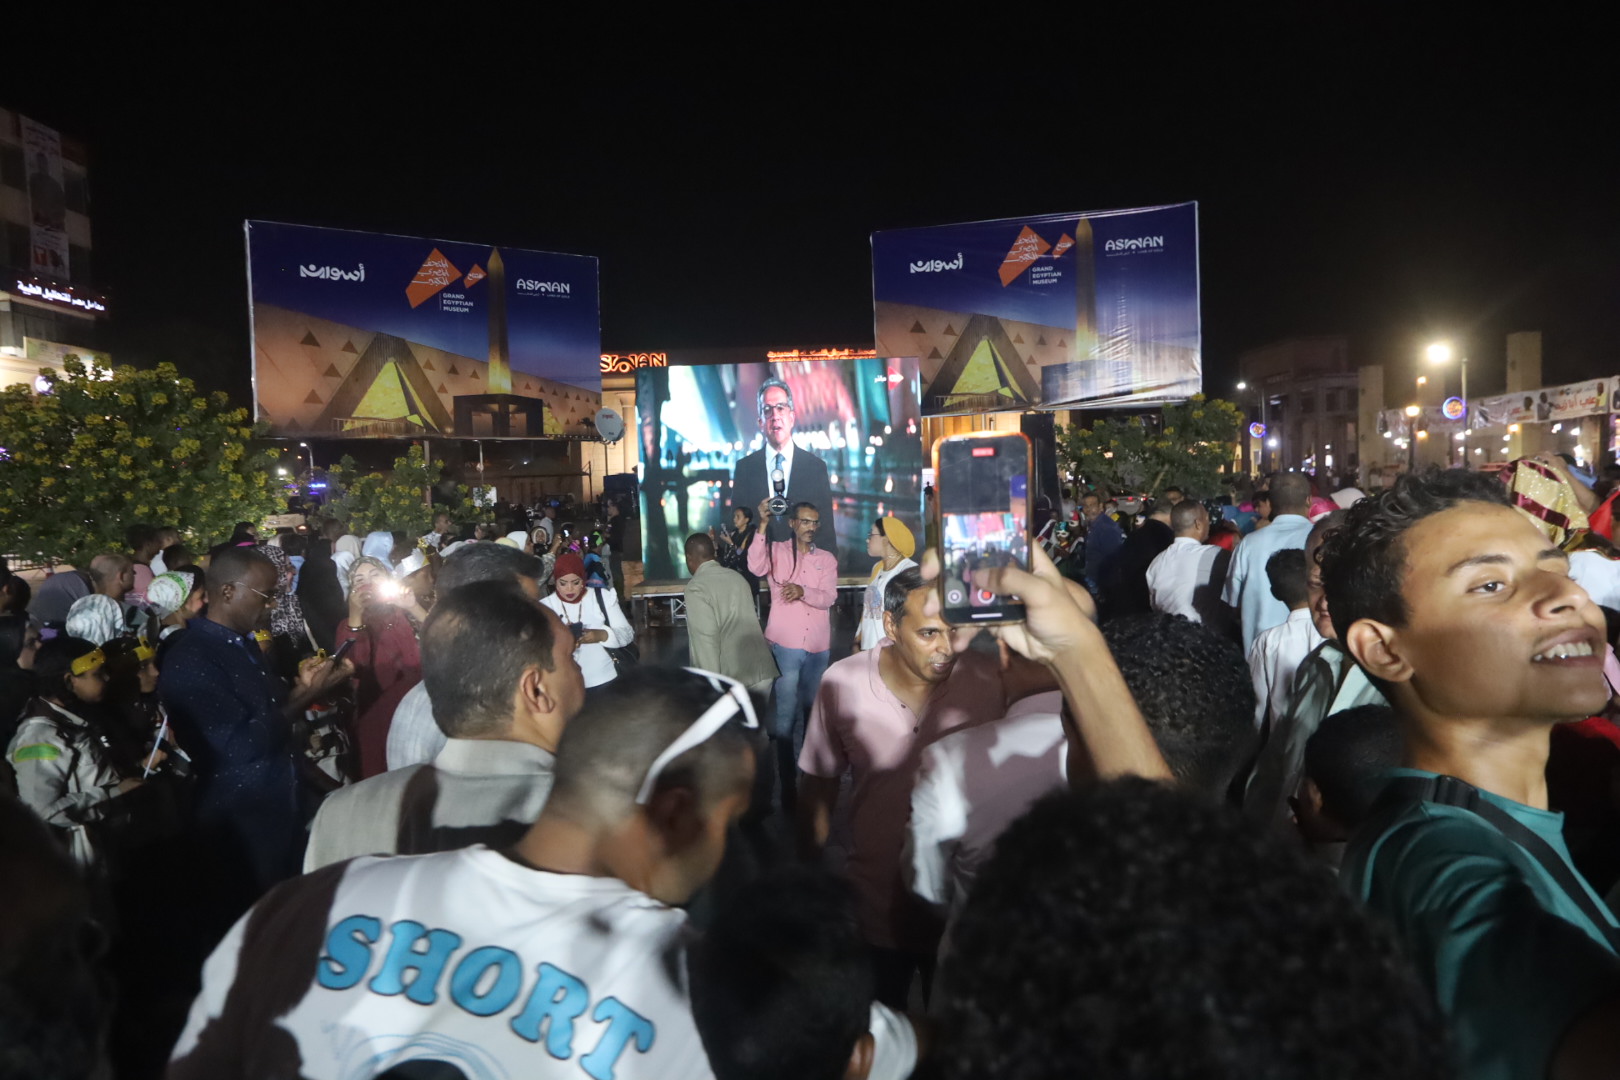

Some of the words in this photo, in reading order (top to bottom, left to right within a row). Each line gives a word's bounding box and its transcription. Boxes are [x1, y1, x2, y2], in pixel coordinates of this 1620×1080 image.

[909, 252, 963, 273] أسوان
[1032, 265, 1054, 273] GRAND
[299, 263, 366, 282] أسوان
[1032, 271, 1062, 279] EGYPTIAN
[443, 292, 465, 300] GRAND
[443, 299, 474, 307] EGYPTIAN
[600, 352, 667, 373] SWAN
[316, 914, 656, 1080] SHORT
